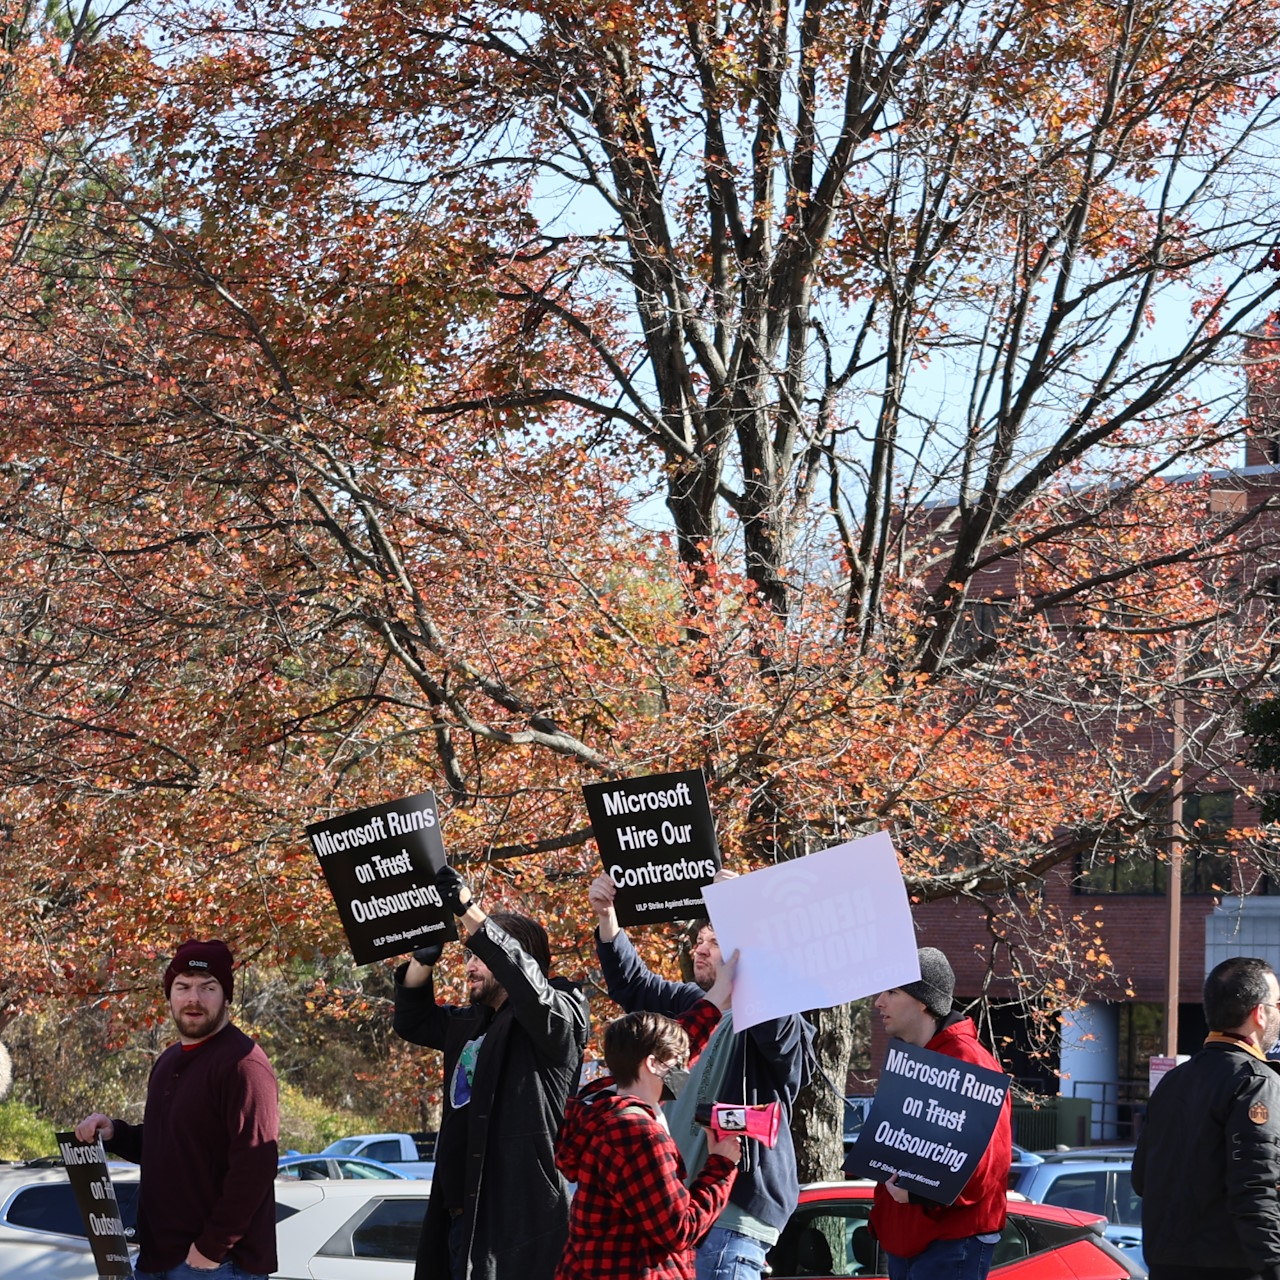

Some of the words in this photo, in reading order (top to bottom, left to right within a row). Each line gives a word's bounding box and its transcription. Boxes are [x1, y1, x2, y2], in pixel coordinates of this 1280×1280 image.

[602, 782, 692, 816] Microsoft
[312, 816, 387, 857] Microsoft
[387, 808, 435, 836] Runs
[616, 826, 659, 851] Hire
[661, 820, 692, 845] Our
[355, 863, 376, 884] on
[371, 849, 413, 879] Trust
[609, 857, 716, 888] Contractors
[350, 884, 443, 923] Outsourcing
[635, 903, 648, 912] ULP
[648, 901, 664, 911] Strike
[665, 899, 683, 909] Against
[684, 898, 706, 906] Microso
[373, 937, 385, 947] ULP
[385, 933, 403, 945] Strike
[402, 928, 422, 940] Against
[421, 921, 446, 934] Microsoft
[885, 1048, 961, 1092] Microsoft
[961, 1073, 1004, 1107] Runs
[903, 1096, 924, 1118] on
[926, 1098, 966, 1132] Trust
[874, 1121, 968, 1172] Outsourcing
[90, 1180, 105, 1200] on
[869, 1159, 882, 1168] ULP
[881, 1163, 897, 1174] Strike
[897, 1169, 916, 1180] Against
[915, 1173, 940, 1188] Microsoft
